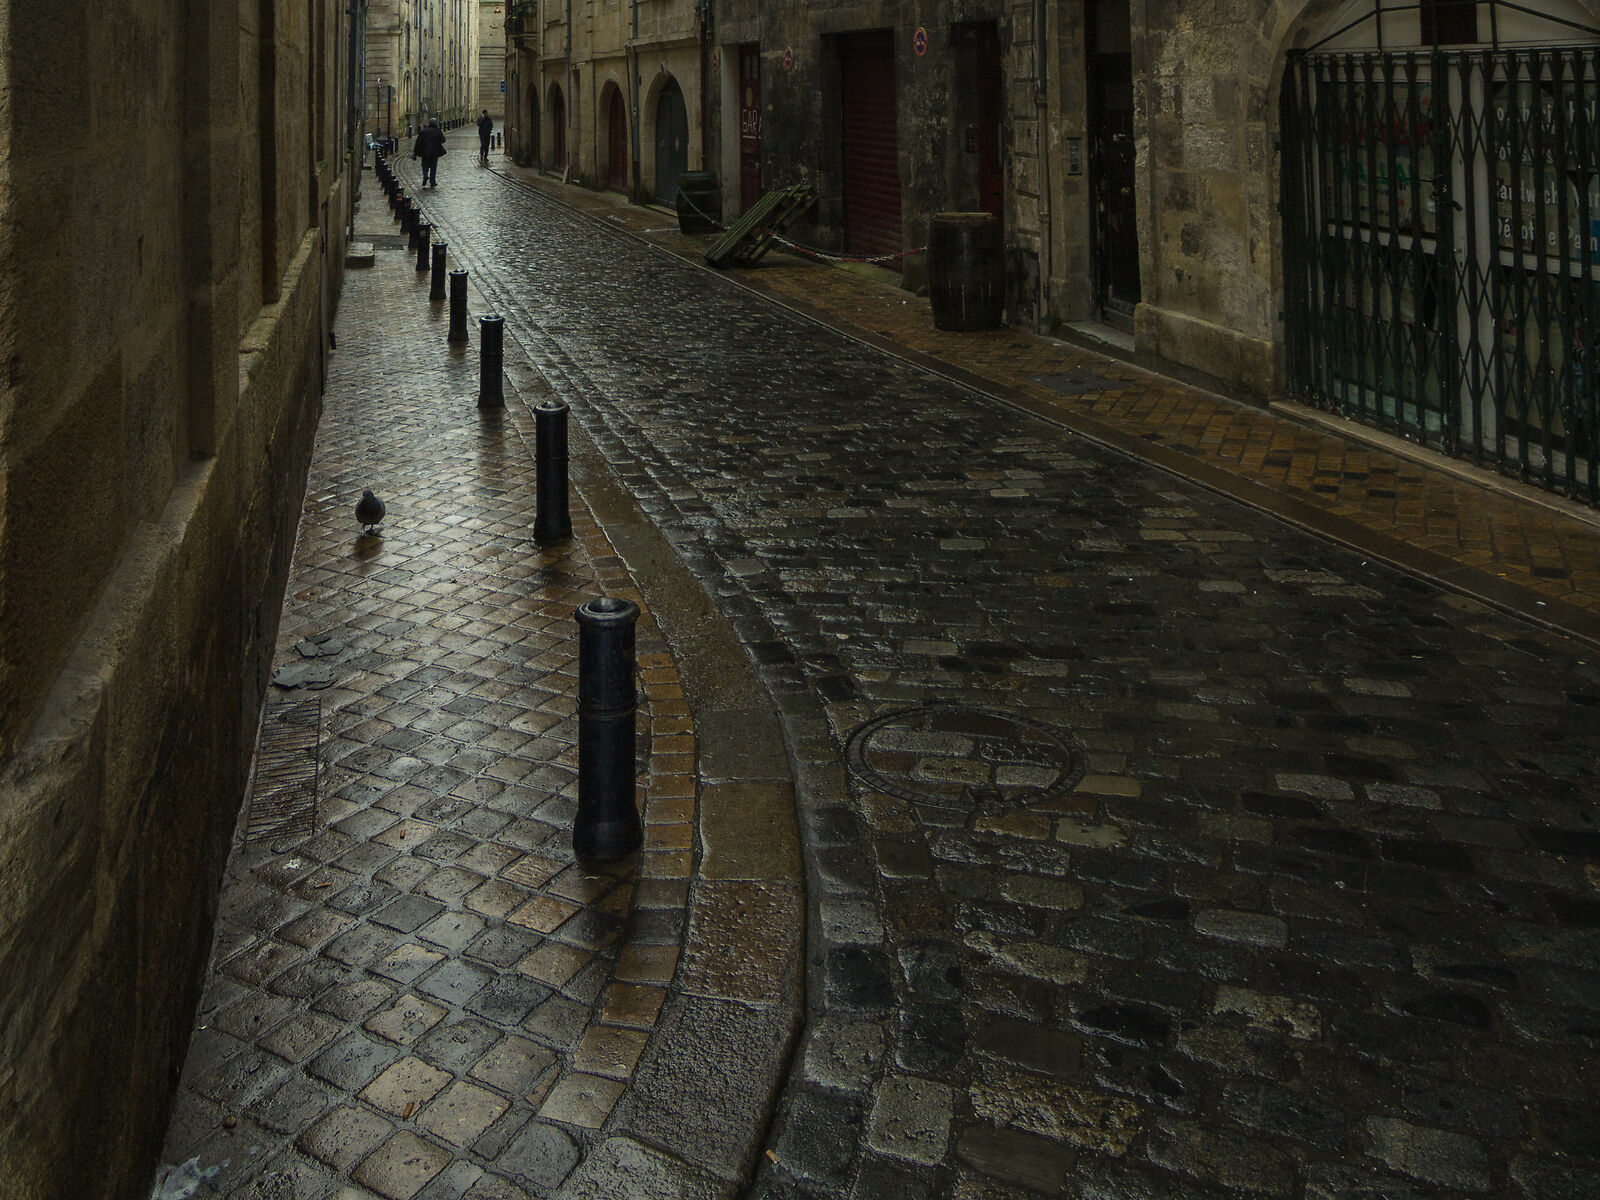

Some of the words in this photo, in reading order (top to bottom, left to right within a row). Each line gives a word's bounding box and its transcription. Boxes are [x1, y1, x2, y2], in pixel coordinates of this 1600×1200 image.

[743, 109, 761, 134] GAR
[1339, 159, 1422, 187] HALA
[1494, 179, 1559, 204] anwch
